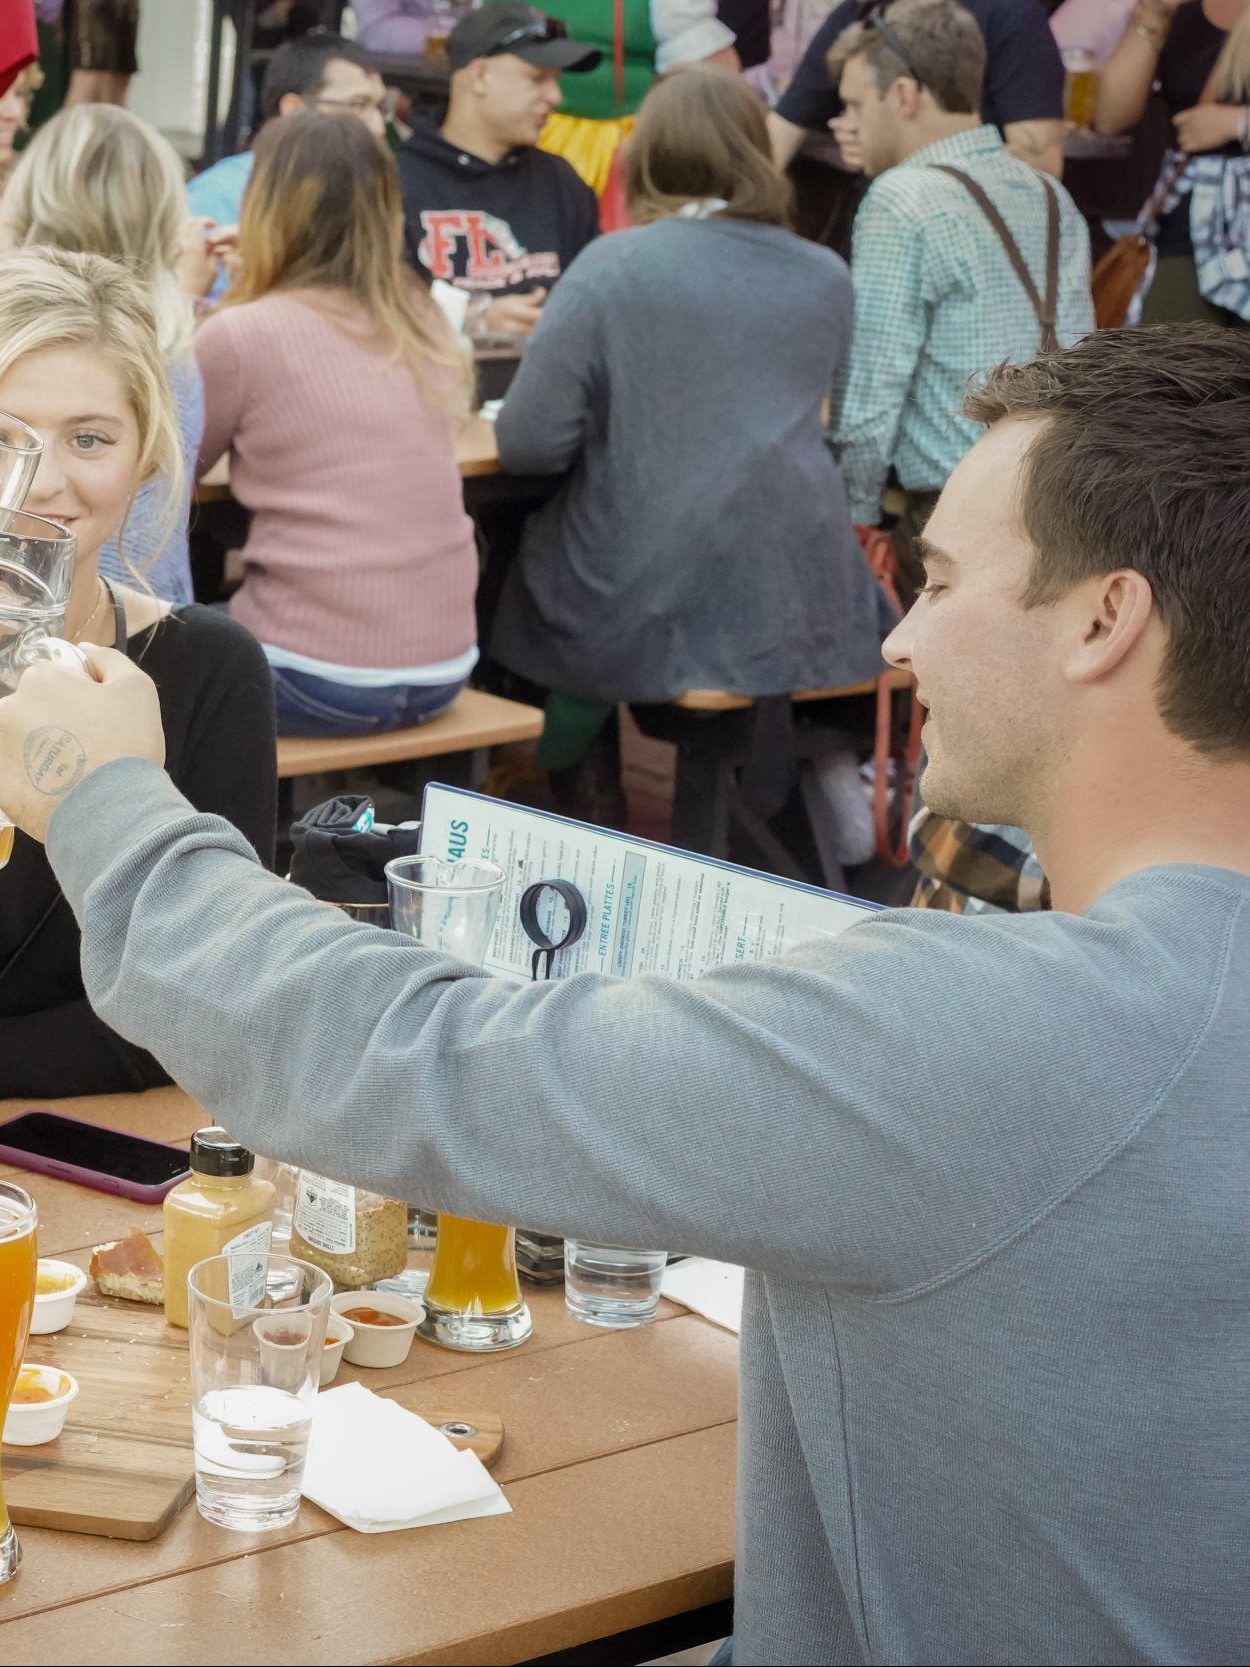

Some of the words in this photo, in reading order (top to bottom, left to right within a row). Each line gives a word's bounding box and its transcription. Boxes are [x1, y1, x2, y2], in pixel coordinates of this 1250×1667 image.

[35, 734, 71, 784] SATURDAY
[446, 819, 468, 864] AUS
[603, 883, 613, 920] PLATTES
[598, 921, 609, 956] ENTREE
[734, 935, 746, 961] SERT
